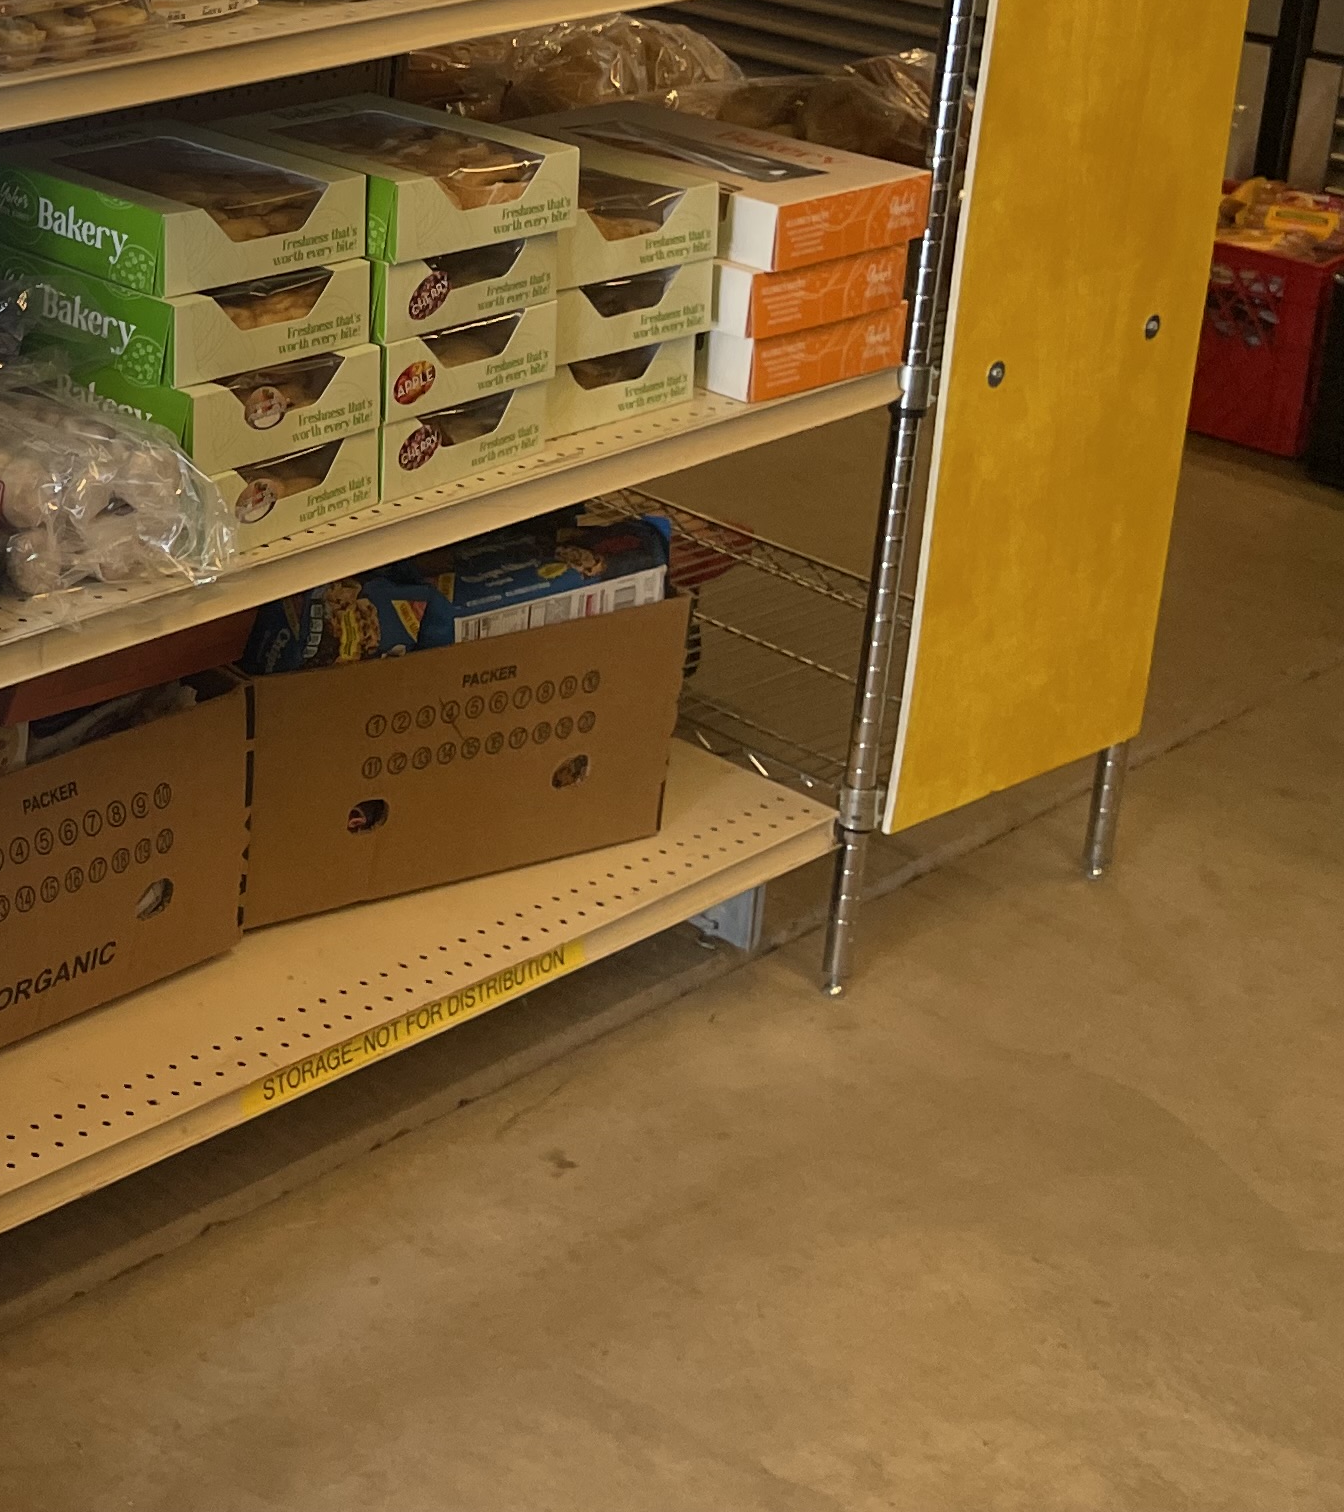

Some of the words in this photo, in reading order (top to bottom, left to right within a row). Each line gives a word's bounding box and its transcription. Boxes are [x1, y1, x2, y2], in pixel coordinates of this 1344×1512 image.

[36, 195, 129, 265] Bakery
[281, 231, 329, 251] Freshness
[331, 226, 357, 244] that's
[272, 250, 304, 266] worth
[306, 246, 333, 263] every
[411, 276, 449, 315] CHERRY
[40, 285, 137, 355] Bakery
[286, 319, 334, 340] Freshness
[396, 368, 434, 399] APPLE
[400, 433, 439, 465] CHERRY
[461, 665, 519, 688] PACKER
[23, 781, 79, 816] PACKER
[406, 1003, 443, 1033] FOR
[447, 950, 566, 1018] DISTRIBUTION
